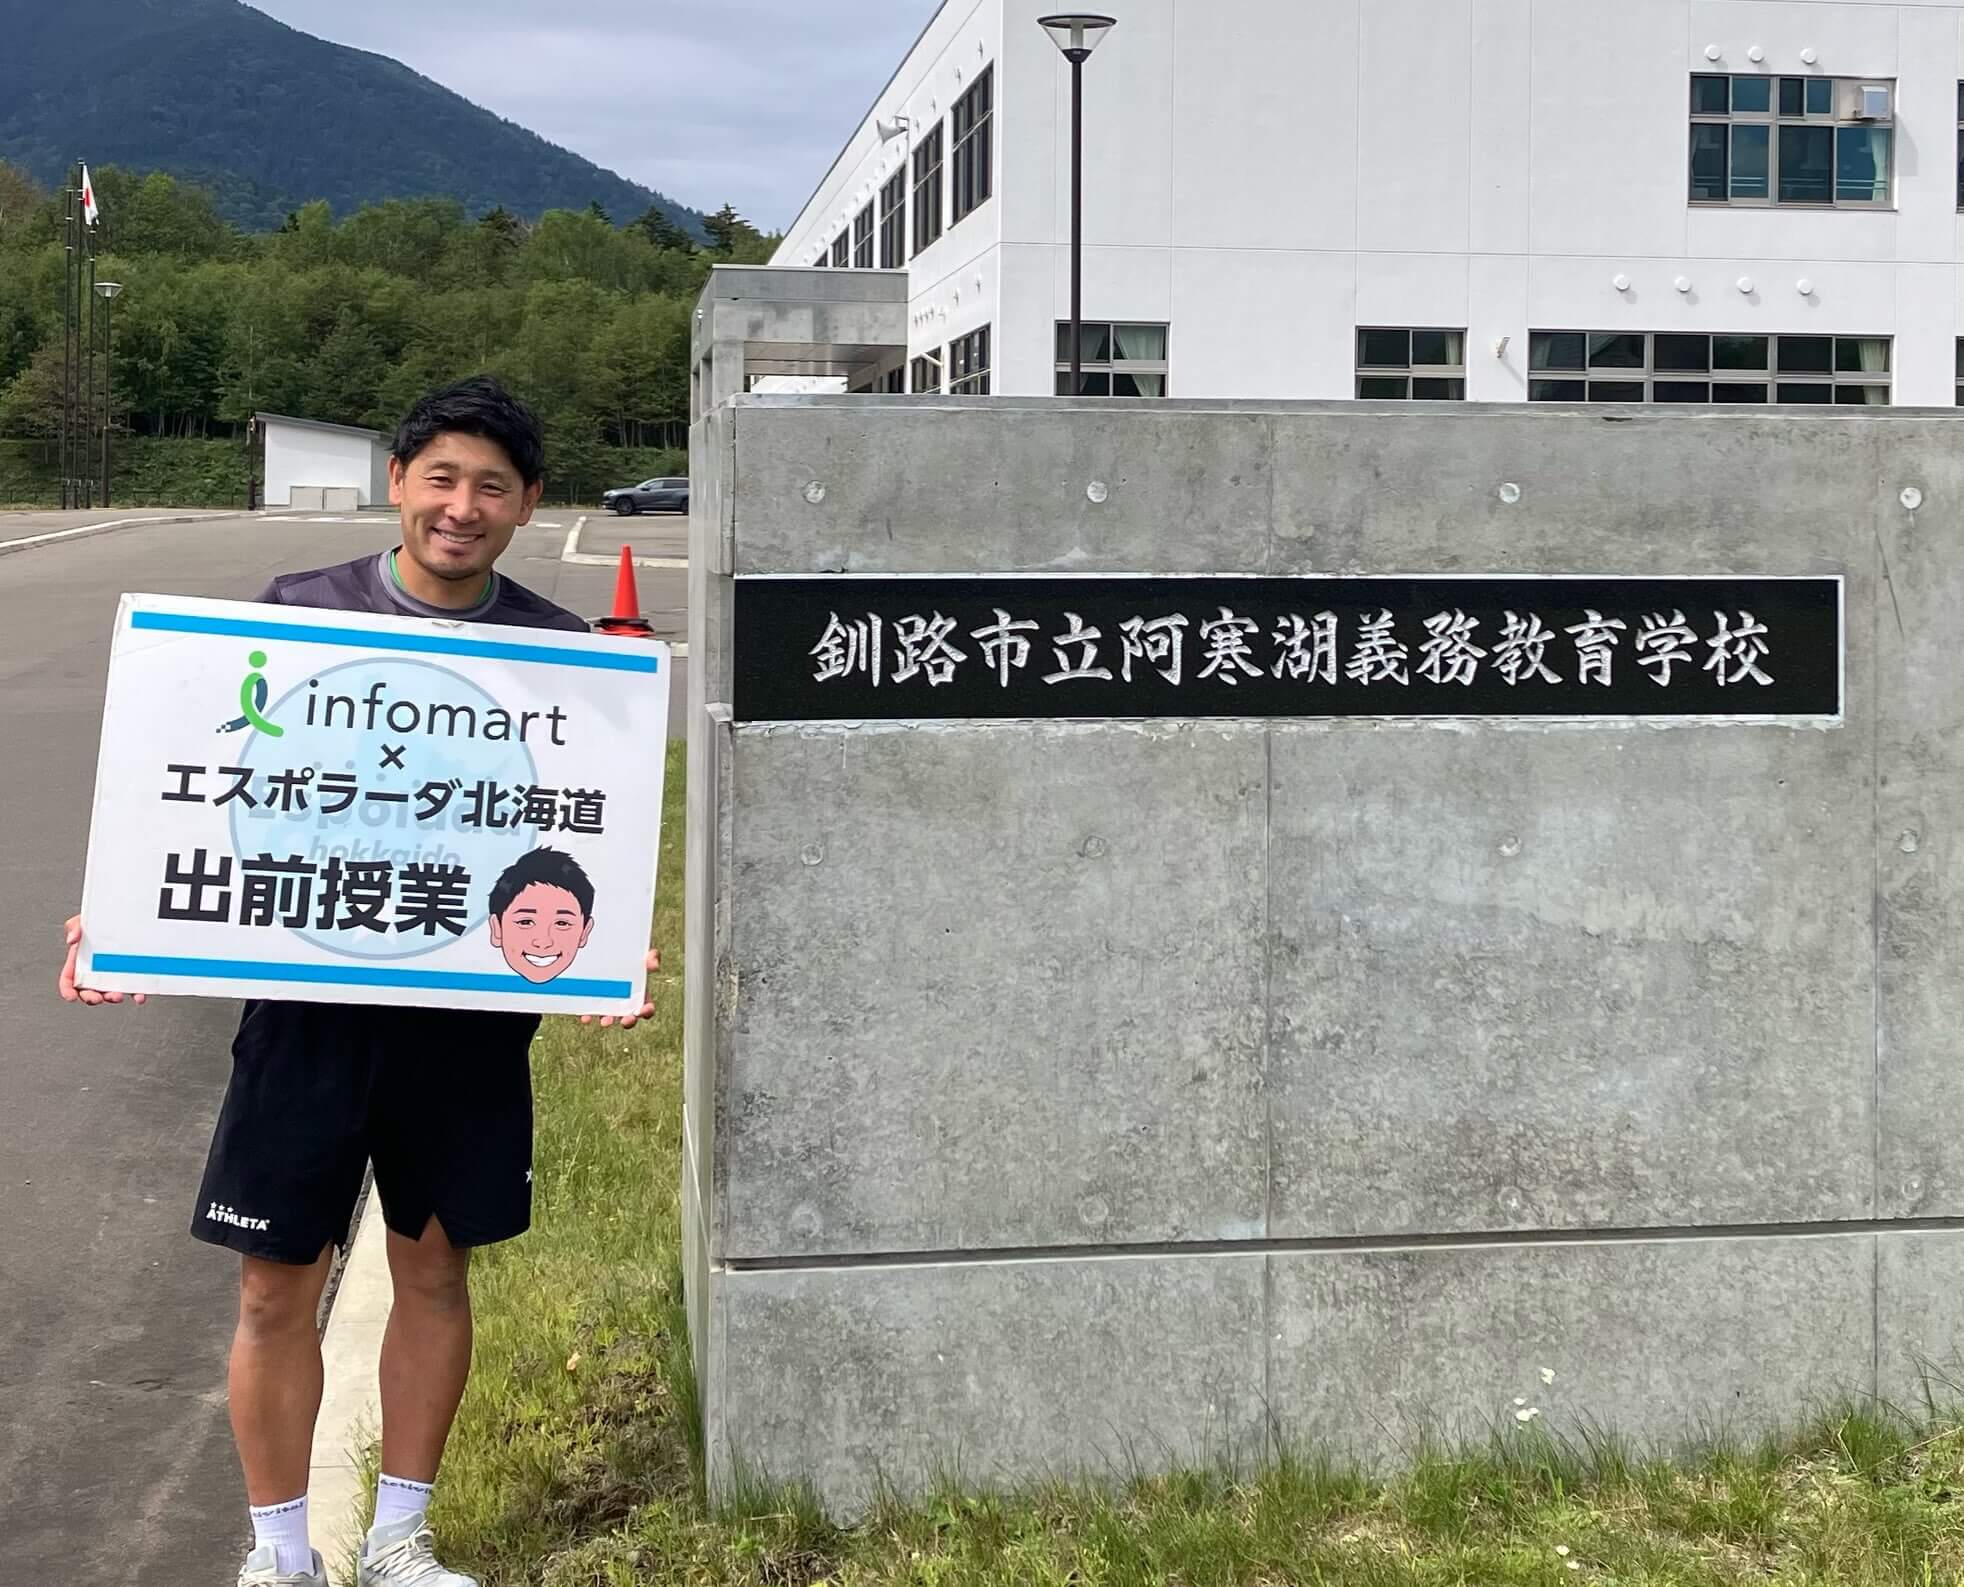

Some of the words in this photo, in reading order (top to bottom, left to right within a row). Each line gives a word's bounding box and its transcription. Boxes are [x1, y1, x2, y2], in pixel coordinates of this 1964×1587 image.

[809, 606, 1775, 687] 釧路市立阿寒湖義務教育学校
[306, 679, 568, 746] infomart
[161, 764, 607, 834] エスポラーダ北海道
[157, 848, 472, 937] 出前授業
[206, 1208, 268, 1231] ATHLETA
